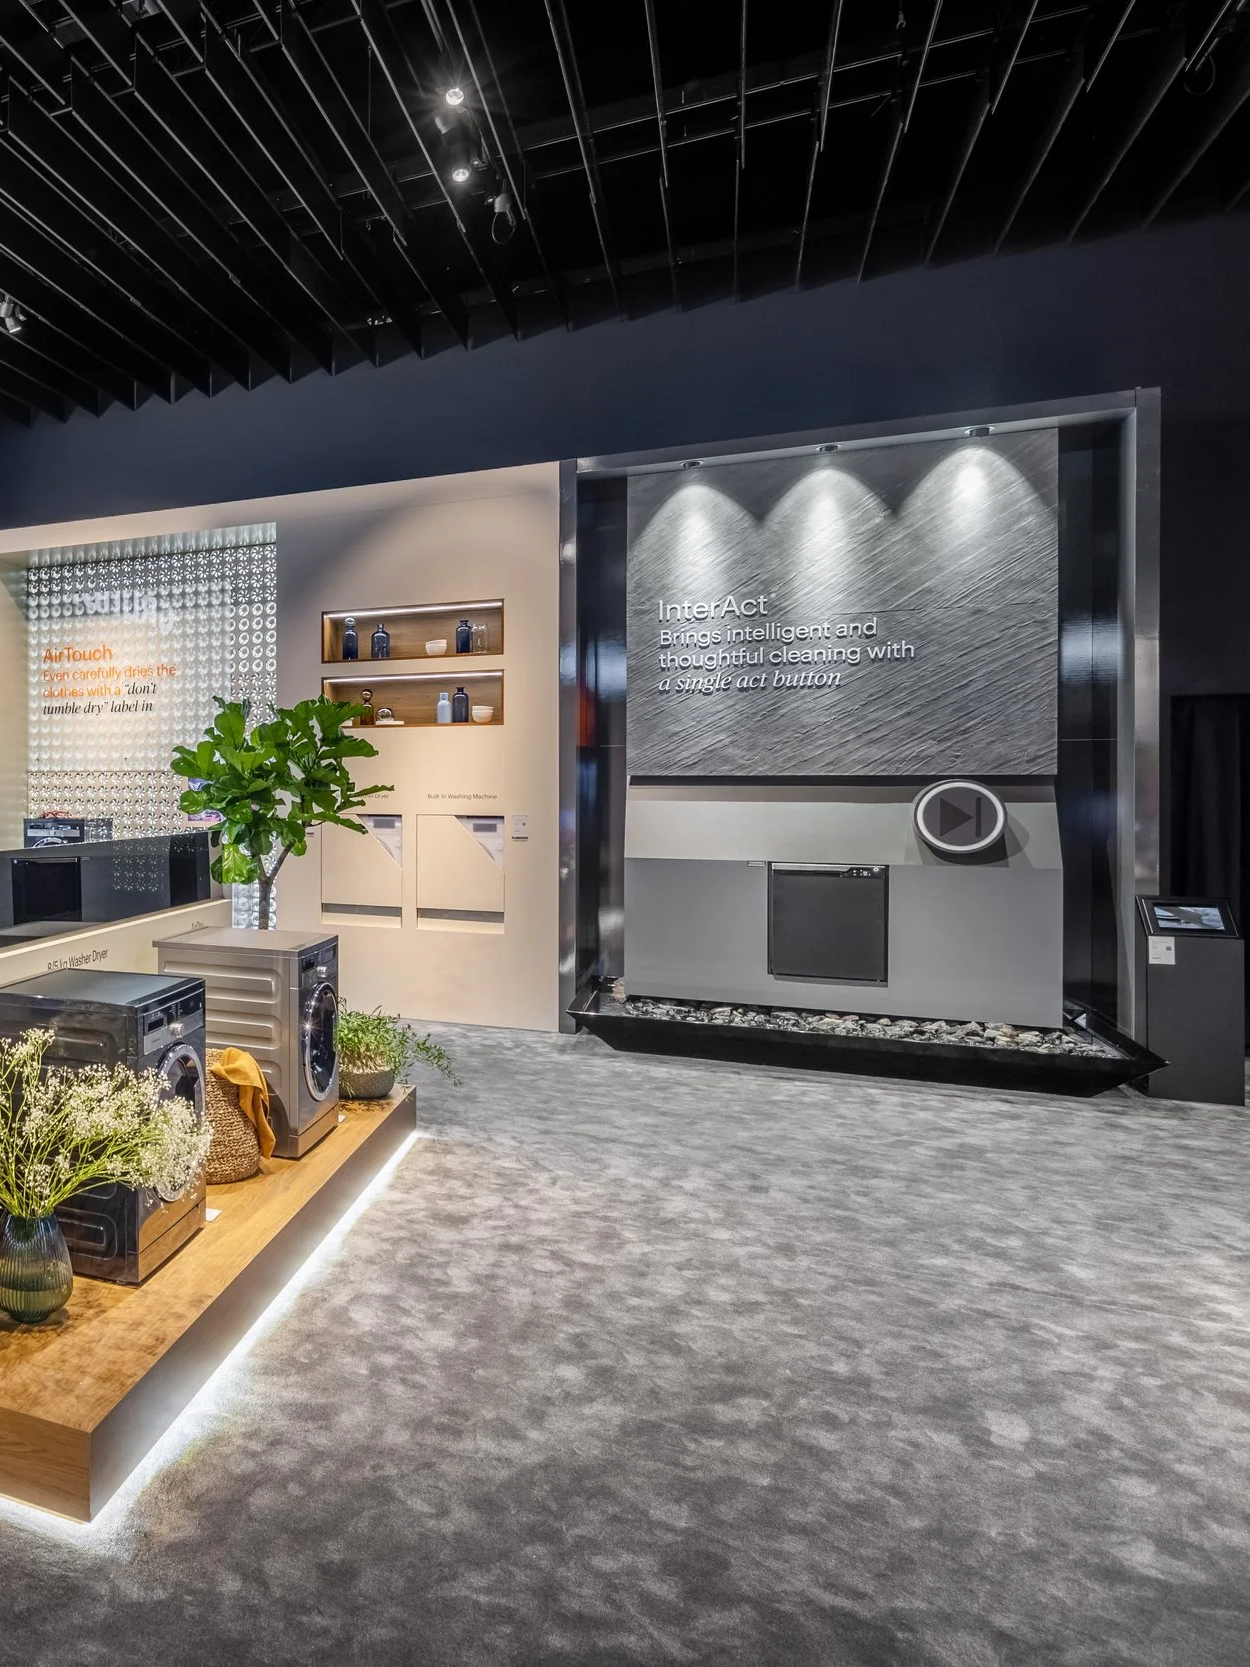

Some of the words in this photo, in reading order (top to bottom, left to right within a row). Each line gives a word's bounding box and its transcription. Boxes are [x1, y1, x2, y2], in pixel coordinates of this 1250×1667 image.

[660, 629, 722, 648] Brings
[727, 622, 831, 643] intelligent
[835, 617, 878, 638] and
[43, 643, 113, 663] AirTouch
[659, 647, 764, 670] thoughtful
[769, 645, 862, 665] cleaning
[867, 640, 915, 660] with
[43, 670, 70, 681] Even
[72, 666, 121, 681] carefully
[124, 665, 153, 678] dries
[156, 663, 176, 676] the
[658, 680, 670, 691] a
[675, 672, 732, 693] single
[736, 674, 768, 690] act
[772, 670, 841, 688] button
[43, 685, 84, 698] clothes
[86, 684, 111, 697] with
[114, 687, 121, 696] a
[43, 702, 81, 715] tumble
[110, 700, 138, 713] label
[141, 699, 153, 712] in
[447, 793, 472, 801] Washing
[69, 953, 91, 967] Washer
[92, 949, 108, 962] Dryer
